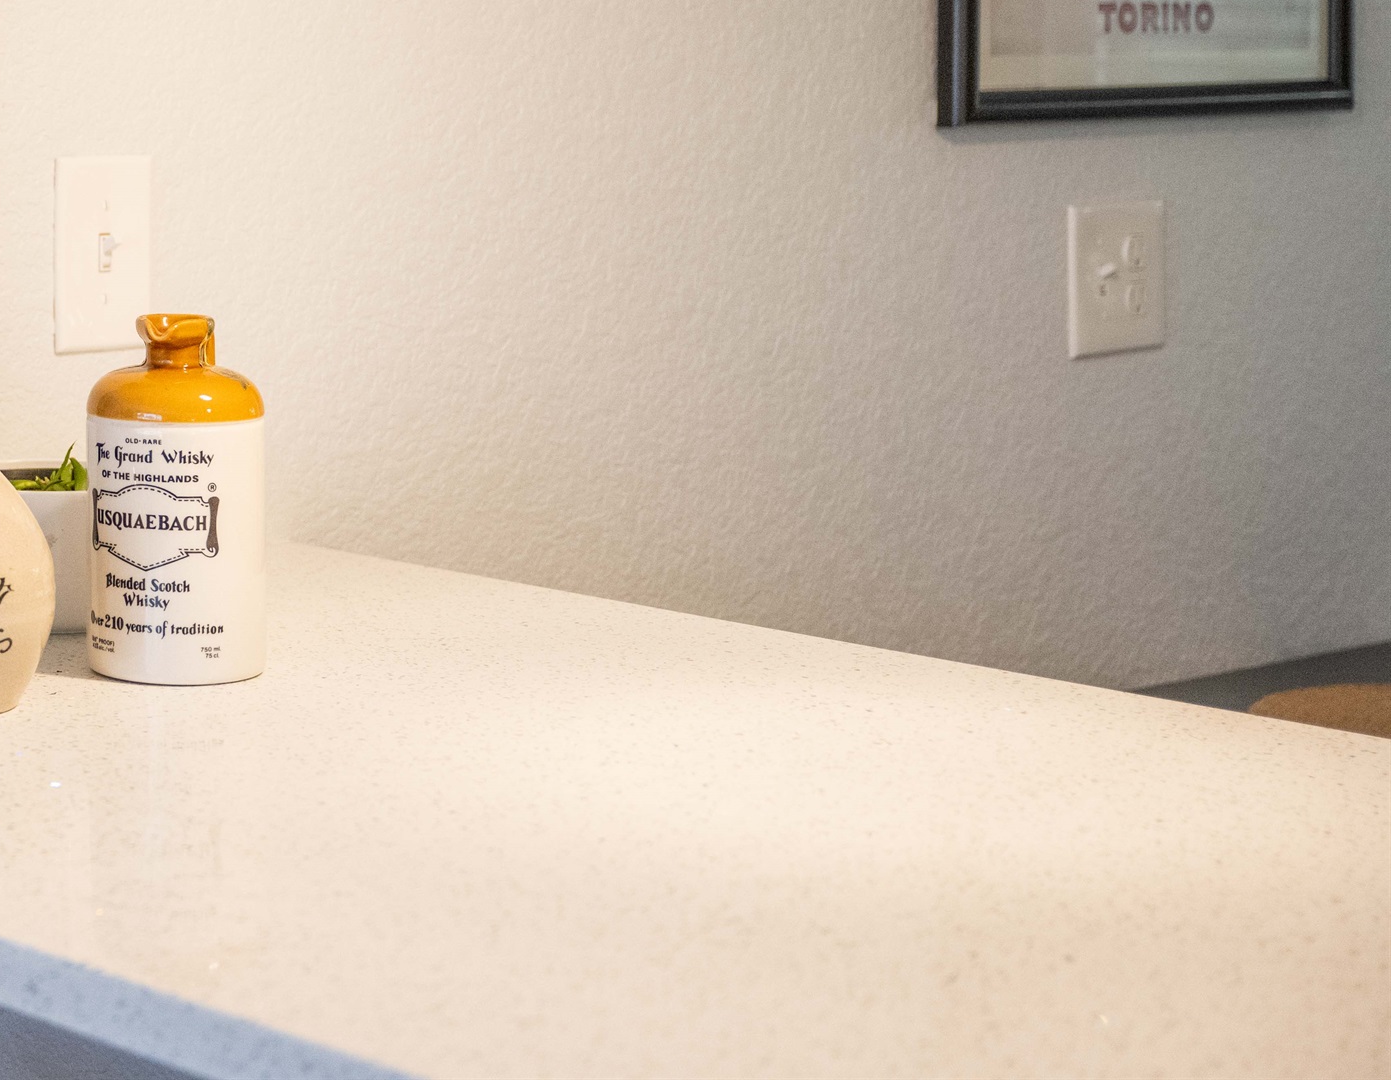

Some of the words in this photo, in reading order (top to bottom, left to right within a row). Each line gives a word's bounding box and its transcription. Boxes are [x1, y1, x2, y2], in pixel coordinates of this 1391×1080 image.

[1098, 1, 1215, 35] TORINO
[125, 437, 162, 446] OLD-RARE
[95, 442, 110, 466] The
[114, 445, 153, 468] Grand
[160, 449, 215, 468] Whisky
[101, 469, 111, 479] OF
[113, 471, 131, 481] THE
[133, 473, 199, 483] HIGHLANDS
[97, 508, 208, 531] USQUAEBACH
[105, 573, 146, 591] Blended
[150, 579, 190, 593] Scotch
[122, 592, 170, 611] Whisky
[104, 614, 124, 631] 210
[125, 623, 153, 635] years
[155, 620, 169, 639] of
[171, 623, 224, 636] tradition
